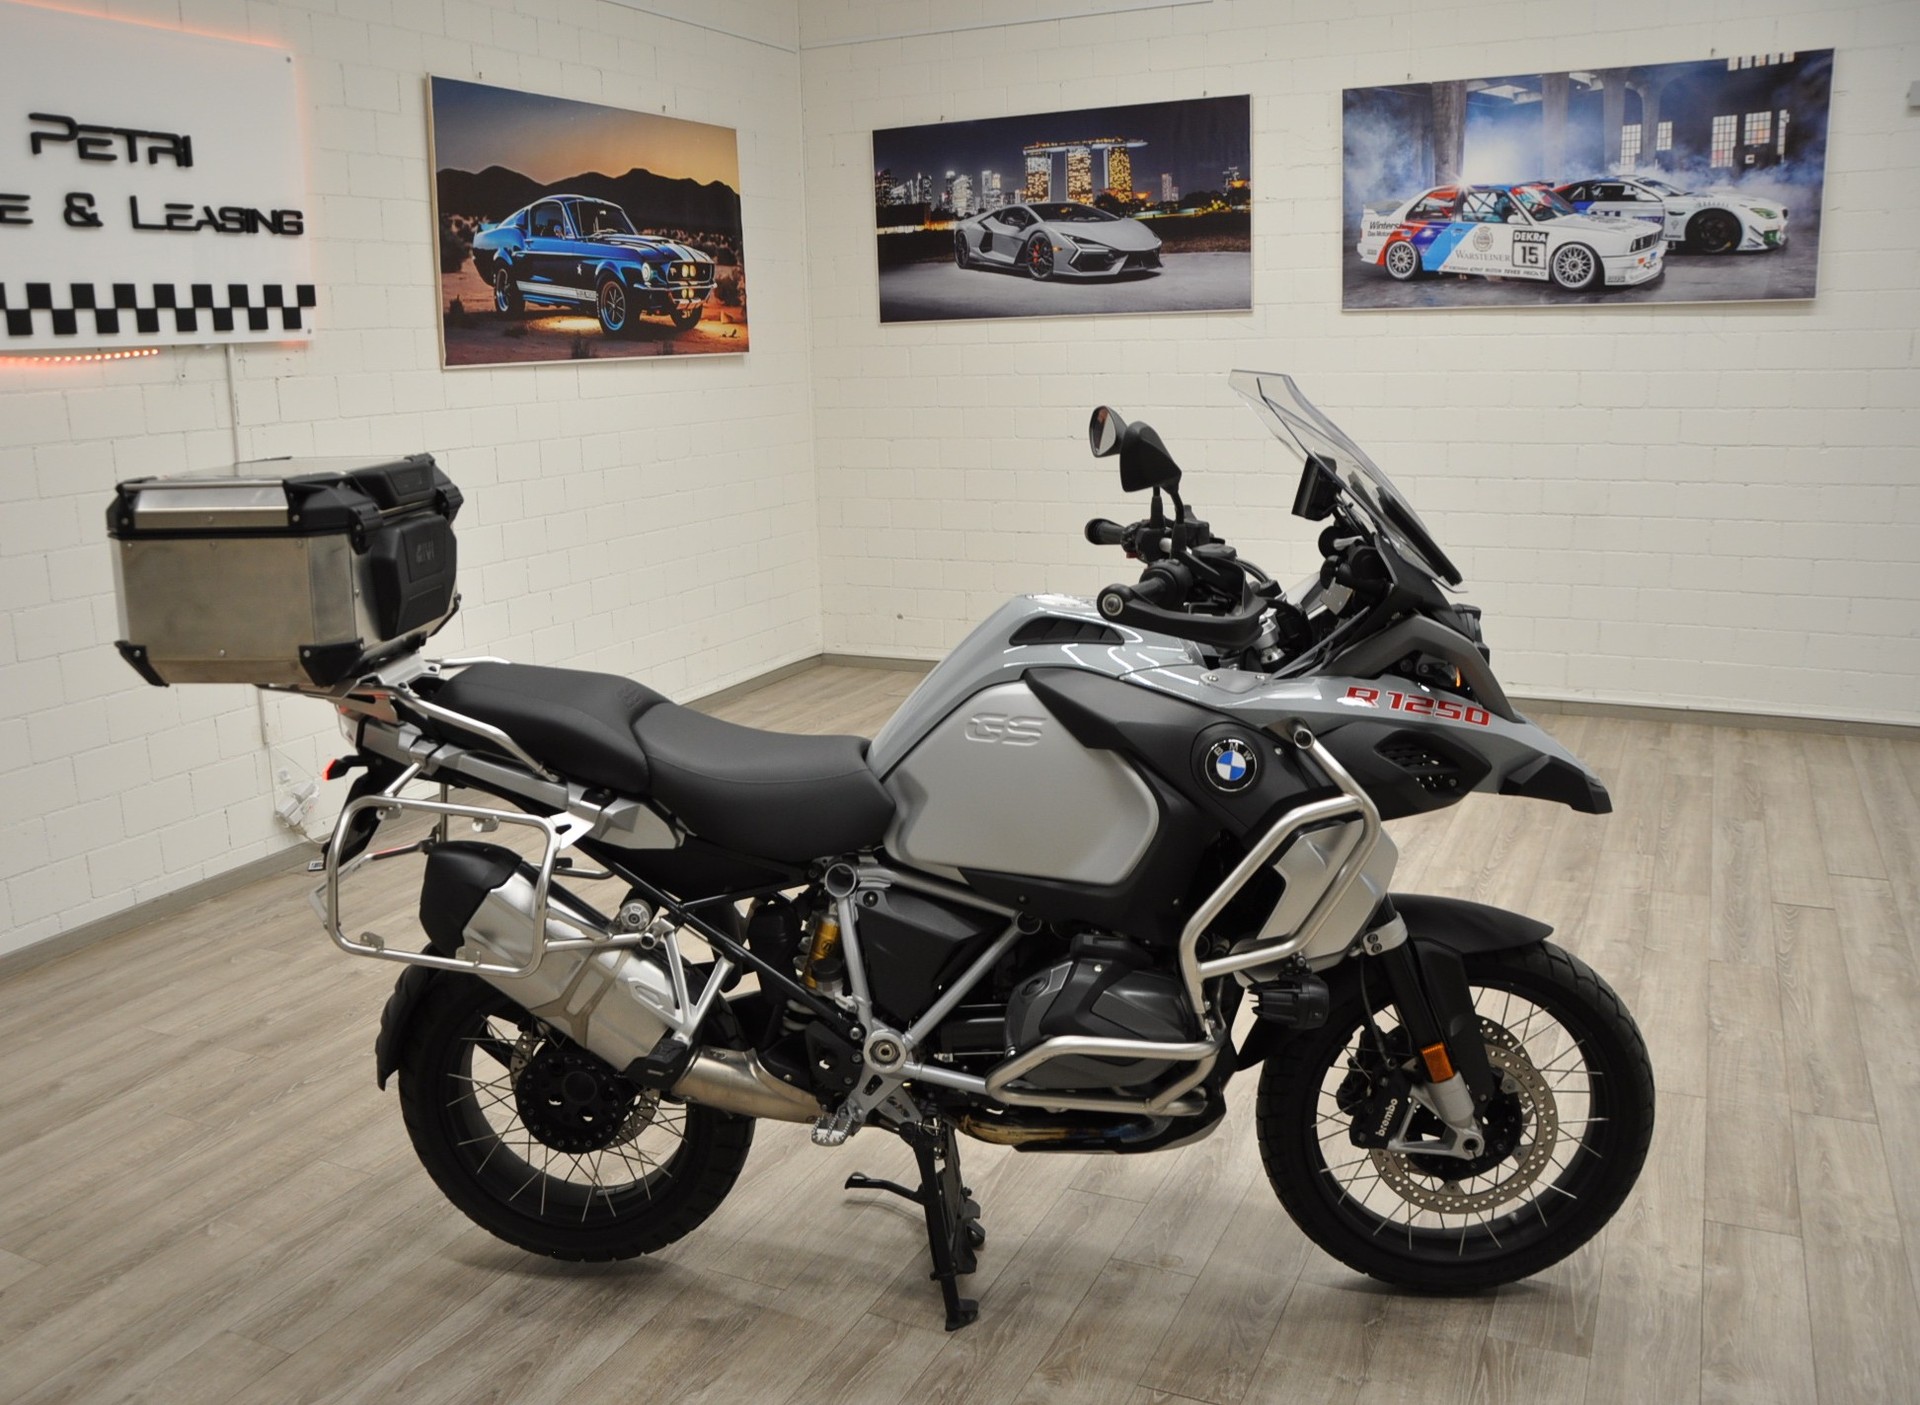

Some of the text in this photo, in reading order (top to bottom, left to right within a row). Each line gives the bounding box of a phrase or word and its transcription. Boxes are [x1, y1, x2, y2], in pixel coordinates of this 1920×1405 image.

[28, 112, 193, 168] PETRI
[63, 191, 104, 228] &
[129, 195, 304, 236] LEASING
[1514, 231, 1547, 241] DEKRA
[1521, 246, 1539, 264] 15
[1386, 690, 1490, 727] 1250
[965, 712, 1046, 746] GS
[1213, 742, 1253, 761] BMW
[1375, 1098, 1398, 1137] brembo
